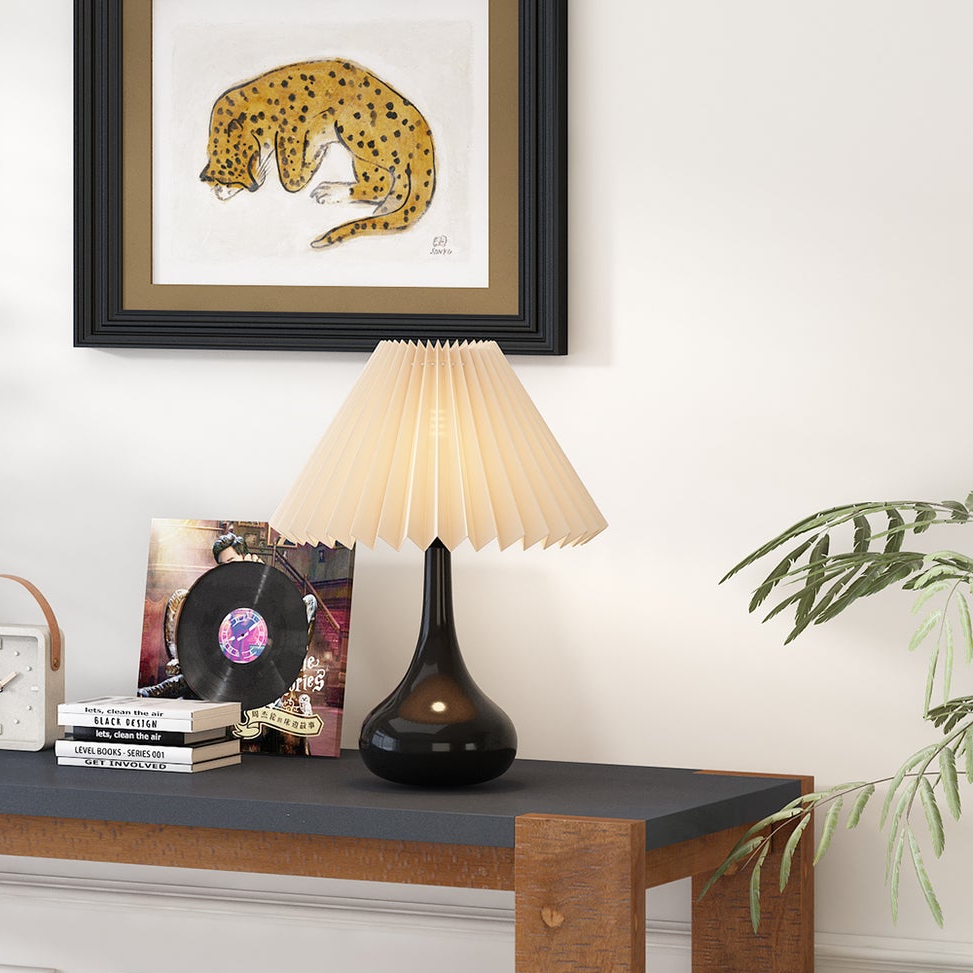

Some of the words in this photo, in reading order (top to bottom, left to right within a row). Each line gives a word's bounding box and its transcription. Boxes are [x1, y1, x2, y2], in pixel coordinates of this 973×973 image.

[94, 717, 121, 726] BLACK
[126, 718, 158, 728] DESIGN
[96, 730, 112, 739] lets,
[114, 731, 134, 740] clean
[136, 732, 149, 740] the
[151, 733, 161, 741] air
[74, 746, 96, 755] LEVEL
[97, 748, 121, 757] BOOKS
[127, 749, 150, 758] SERIES
[110, 760, 167, 770] INVOLVED
